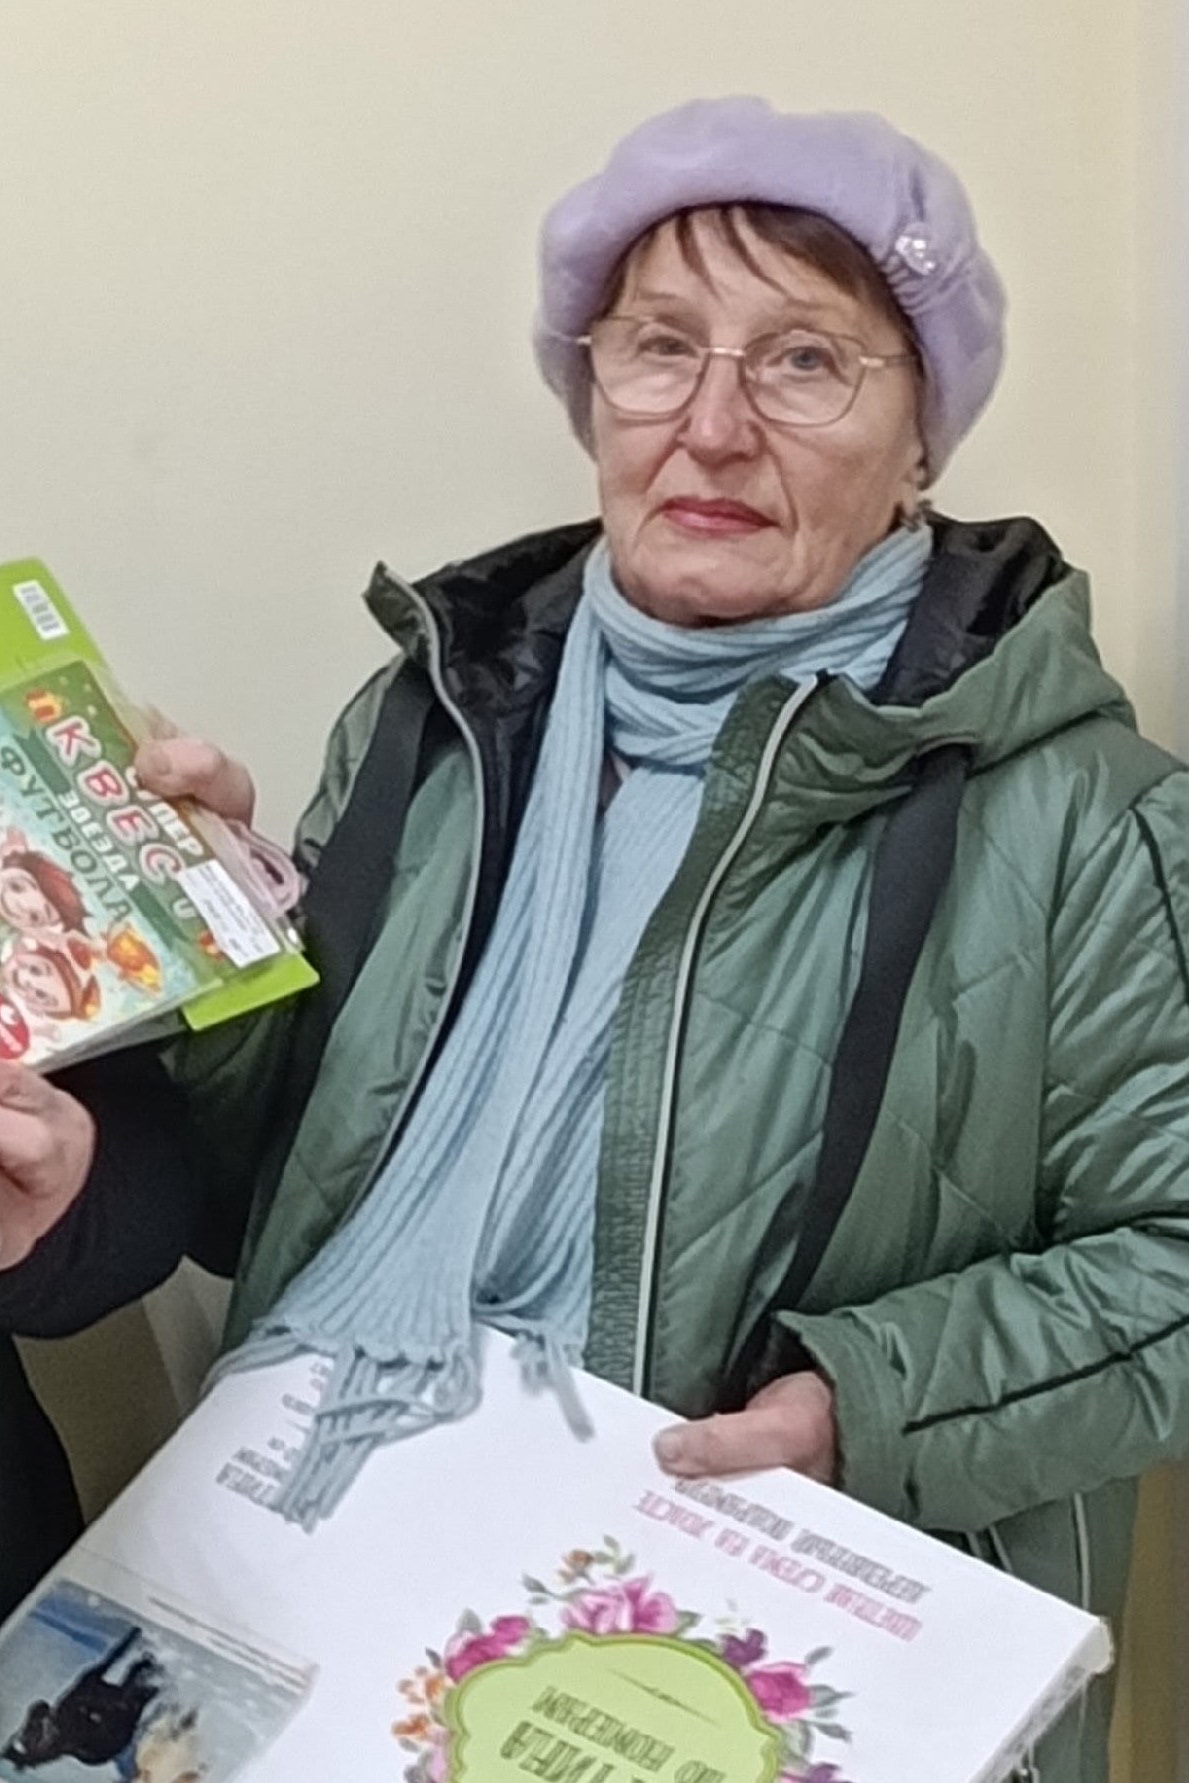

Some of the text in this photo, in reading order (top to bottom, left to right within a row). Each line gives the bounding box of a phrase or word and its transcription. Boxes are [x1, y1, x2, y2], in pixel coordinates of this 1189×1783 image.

[0, 745, 134, 922] ФУТБОЛА
[58, 789, 141, 891] ЗВЕЗДА
[126, 766, 204, 857] ПЕР
[532, 1685, 675, 1772] НОМЕРАМ
